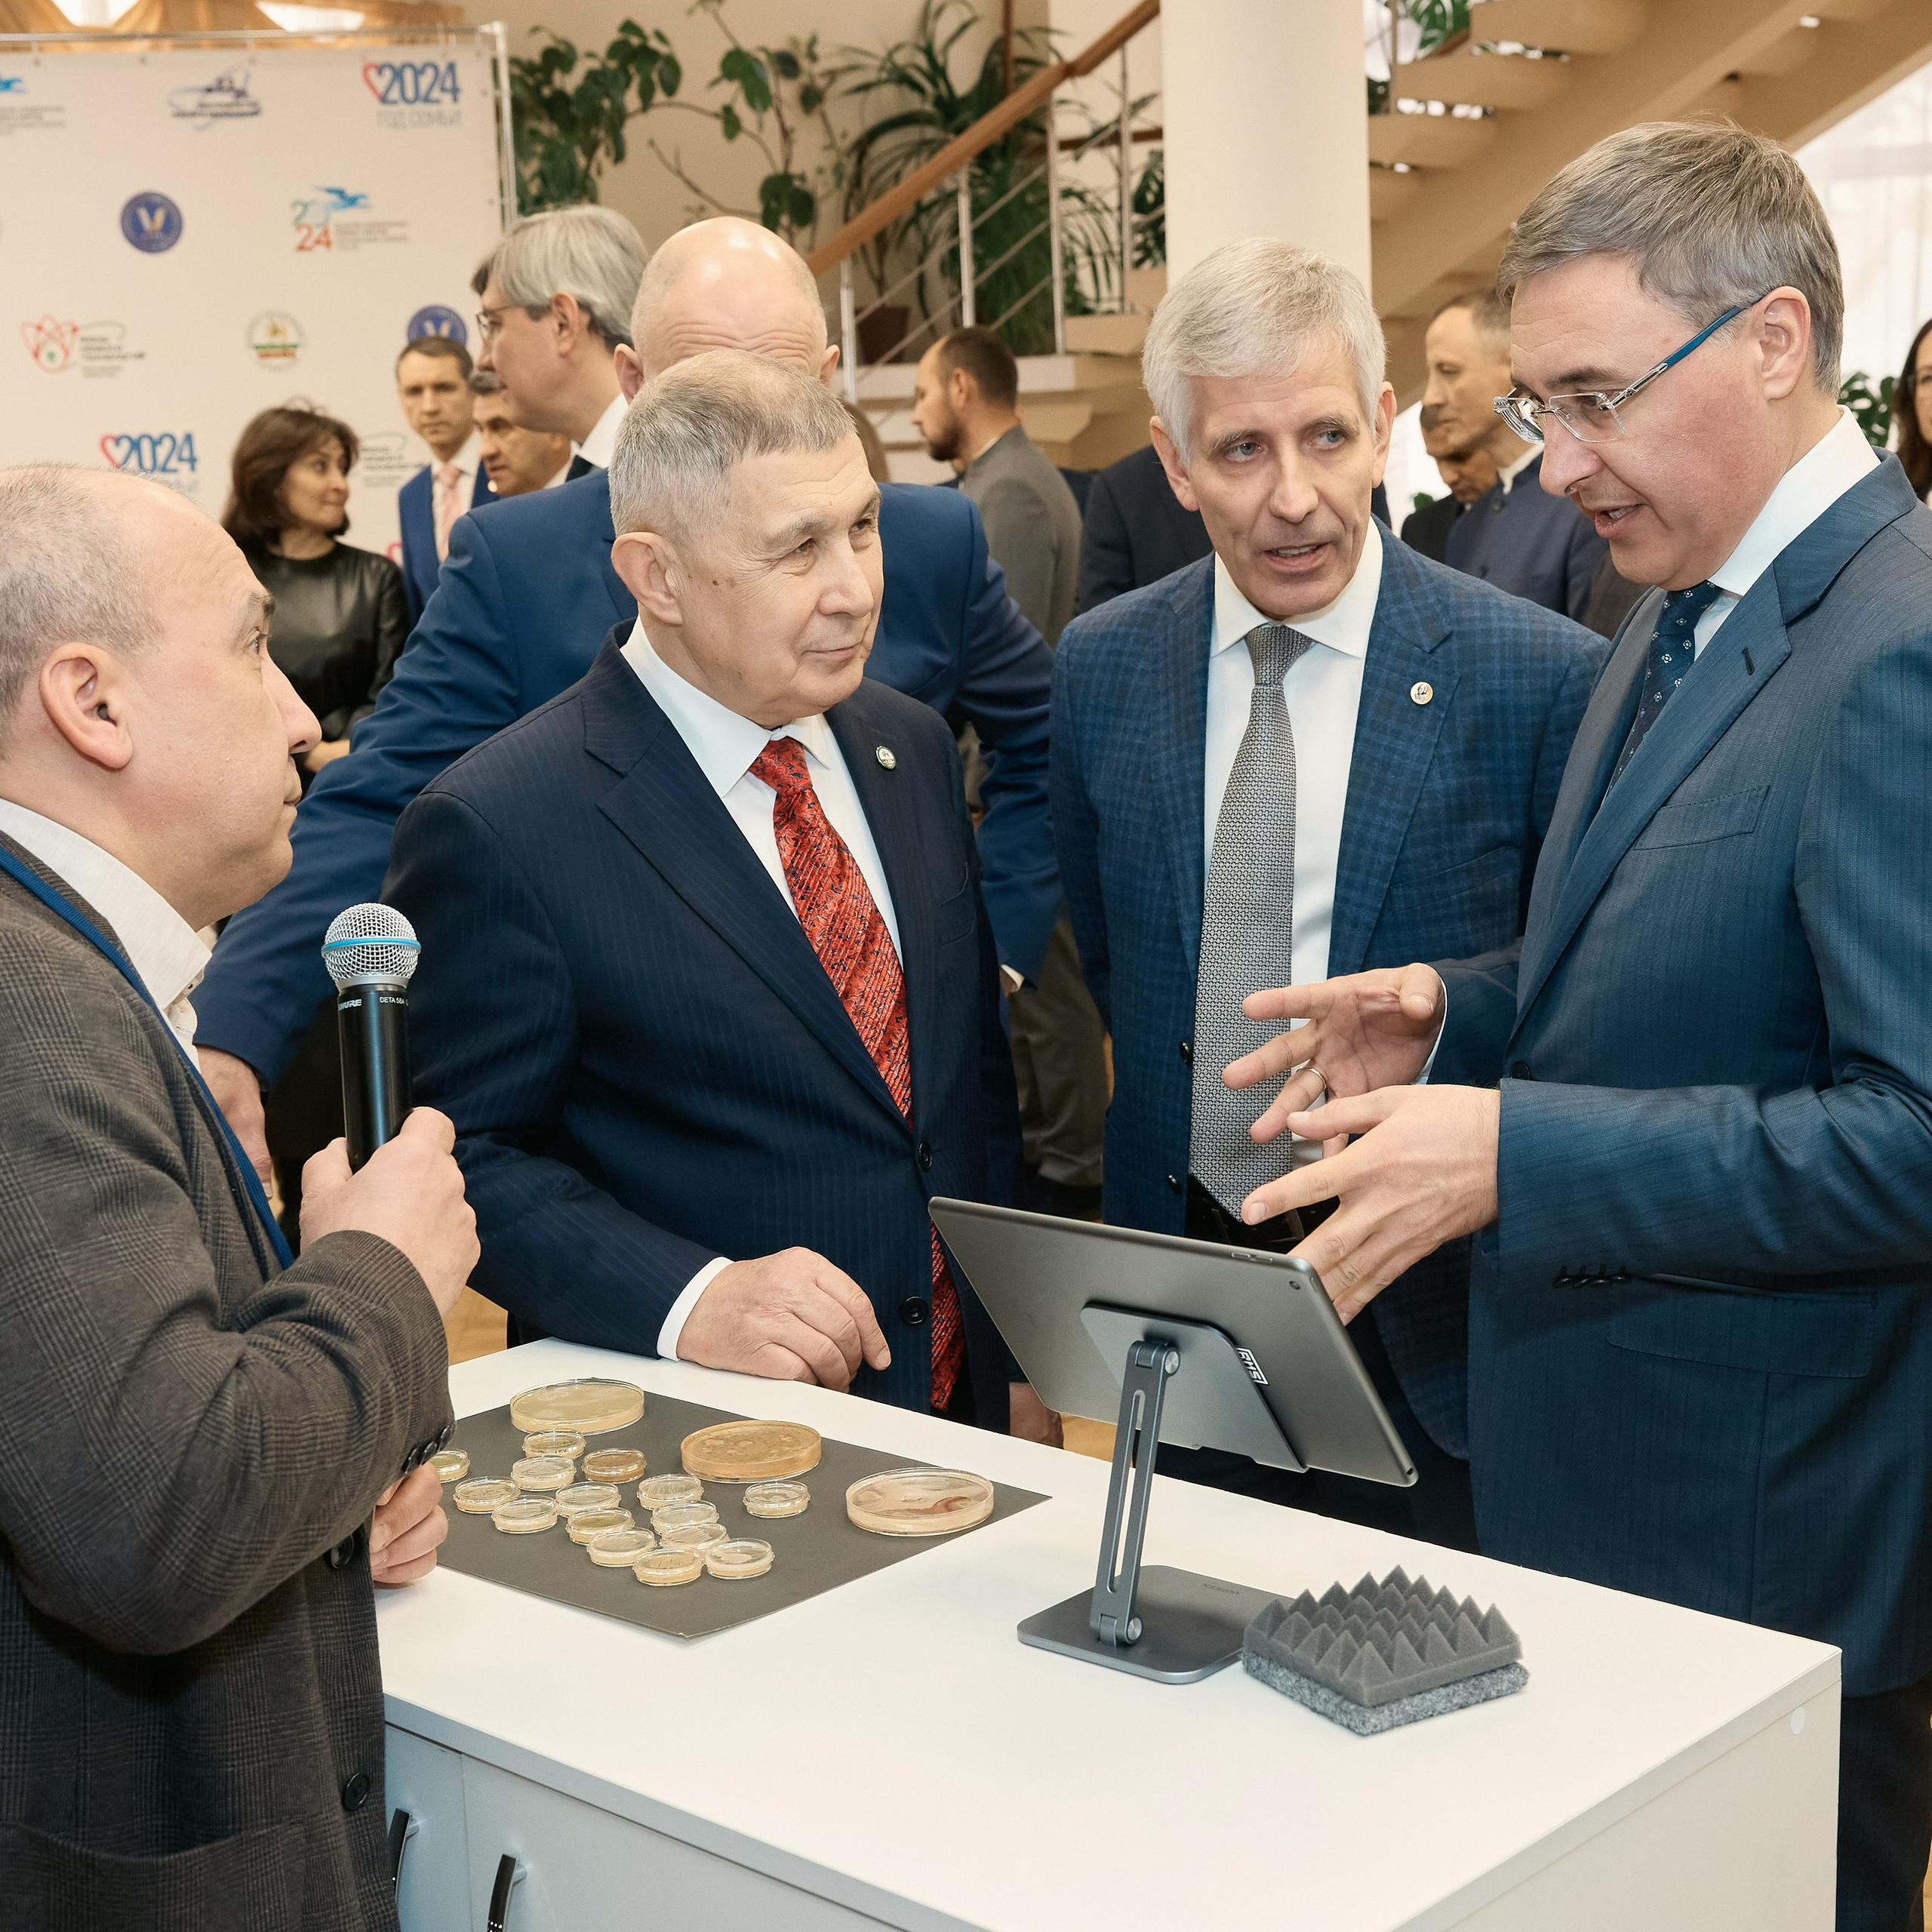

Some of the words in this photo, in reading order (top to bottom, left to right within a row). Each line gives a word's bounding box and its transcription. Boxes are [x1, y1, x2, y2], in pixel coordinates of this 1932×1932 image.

[378, 60, 461, 104] 2024
[294, 223, 332, 252] 24
[115, 432, 198, 473] 2024
